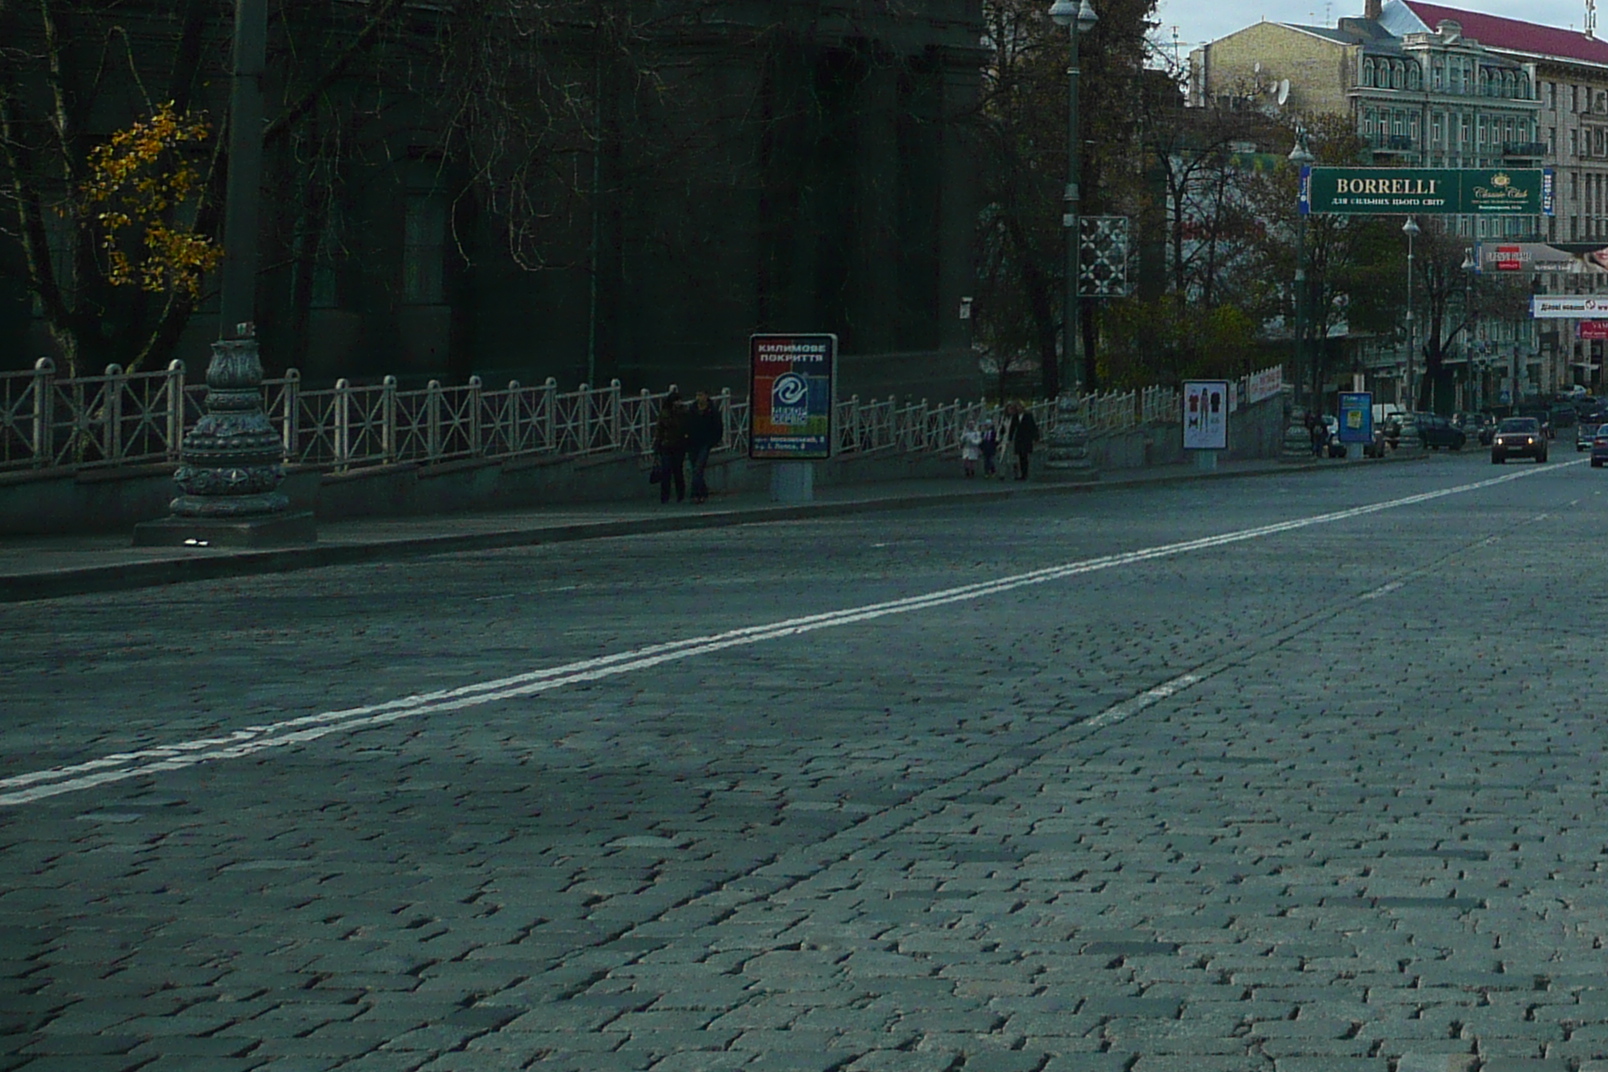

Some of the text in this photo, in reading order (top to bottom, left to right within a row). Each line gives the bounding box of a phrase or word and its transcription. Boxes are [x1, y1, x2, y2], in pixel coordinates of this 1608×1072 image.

[1336, 178, 1436, 194] BORRELLI
[758, 344, 826, 353] КИЛИМОВЕ
[760, 354, 824, 362] ПОКРИТТЯ
